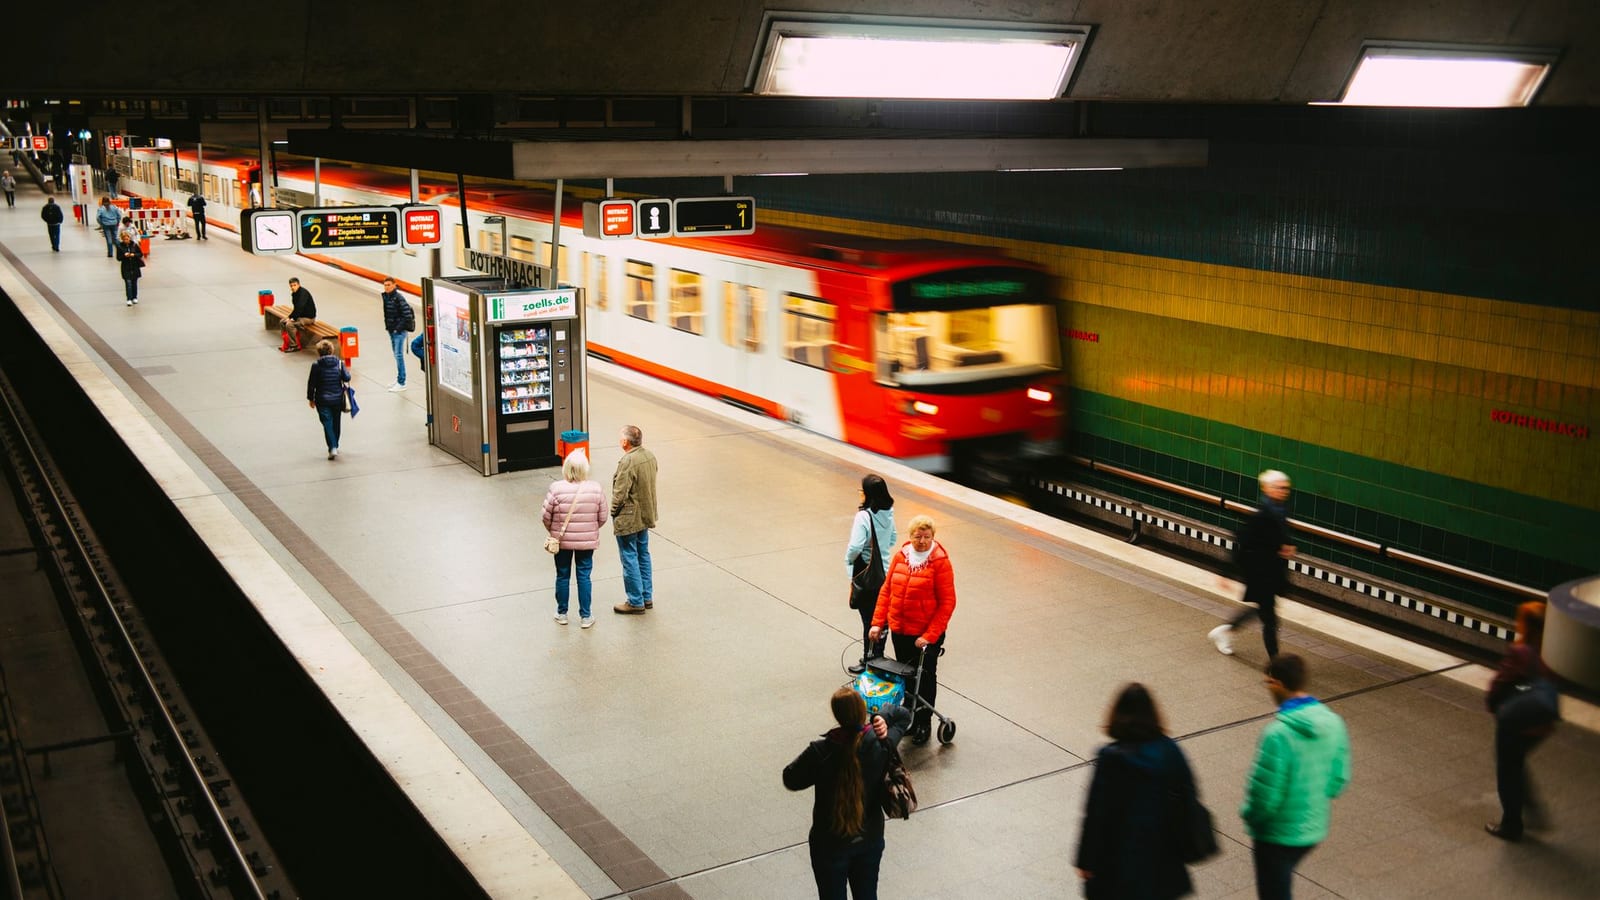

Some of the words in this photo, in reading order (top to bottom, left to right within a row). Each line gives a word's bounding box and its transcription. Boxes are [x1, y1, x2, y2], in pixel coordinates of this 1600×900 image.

[410, 223, 435, 231] NOTRUF
[738, 209, 745, 228] 1
[310, 225, 323, 245] 2
[470, 251, 542, 287] RÖTHENBACH
[522, 295, 569, 311] zoells.de
